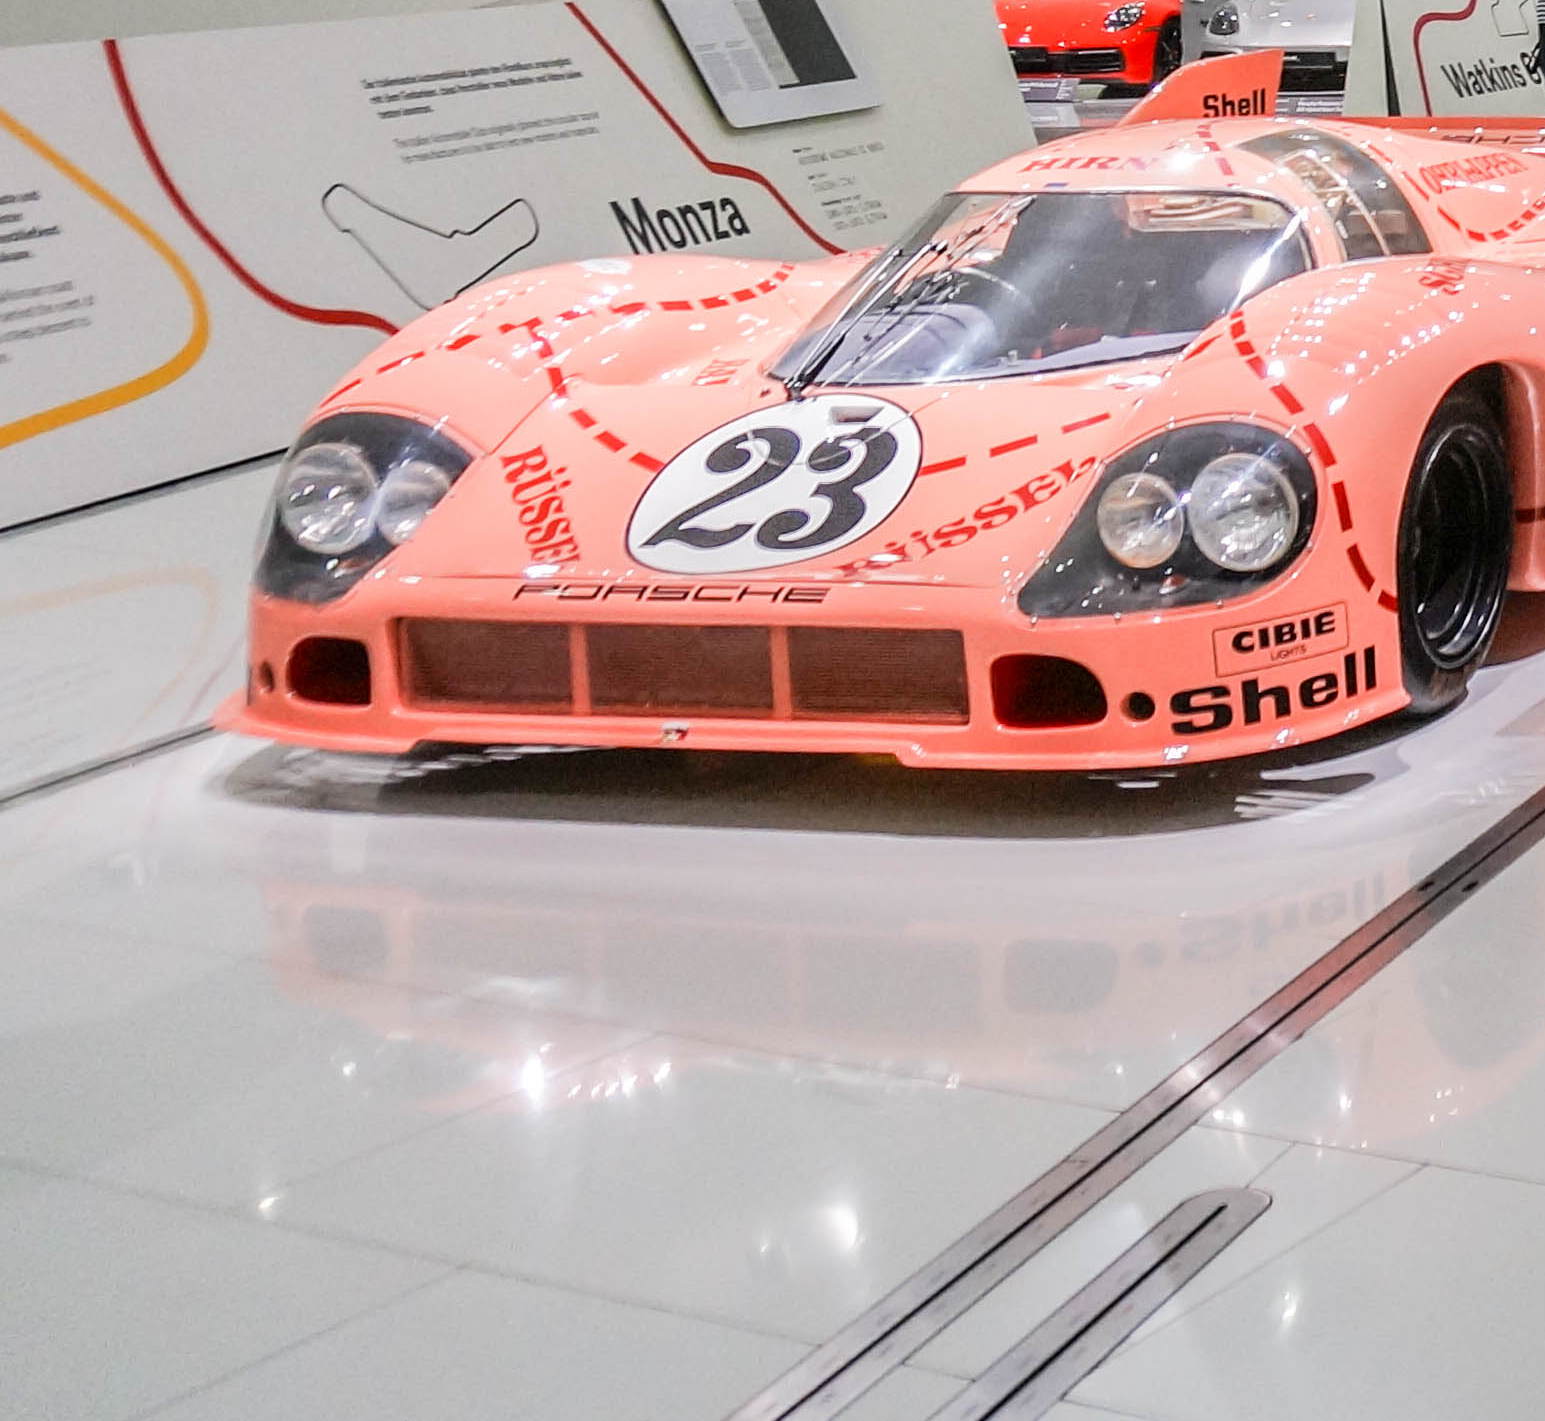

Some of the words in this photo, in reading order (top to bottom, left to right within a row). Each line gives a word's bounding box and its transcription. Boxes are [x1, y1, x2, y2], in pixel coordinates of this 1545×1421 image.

[1440, 57, 1528, 99] Watkins
[1202, 88, 1266, 119] Shell
[1017, 156, 1155, 173] HIRN
[609, 195, 751, 256] Monza
[638, 426, 899, 550] 23
[511, 583, 832, 604] PORSCHE
[1230, 611, 1337, 655] CIBIE
[1171, 645, 1378, 736] Shell
